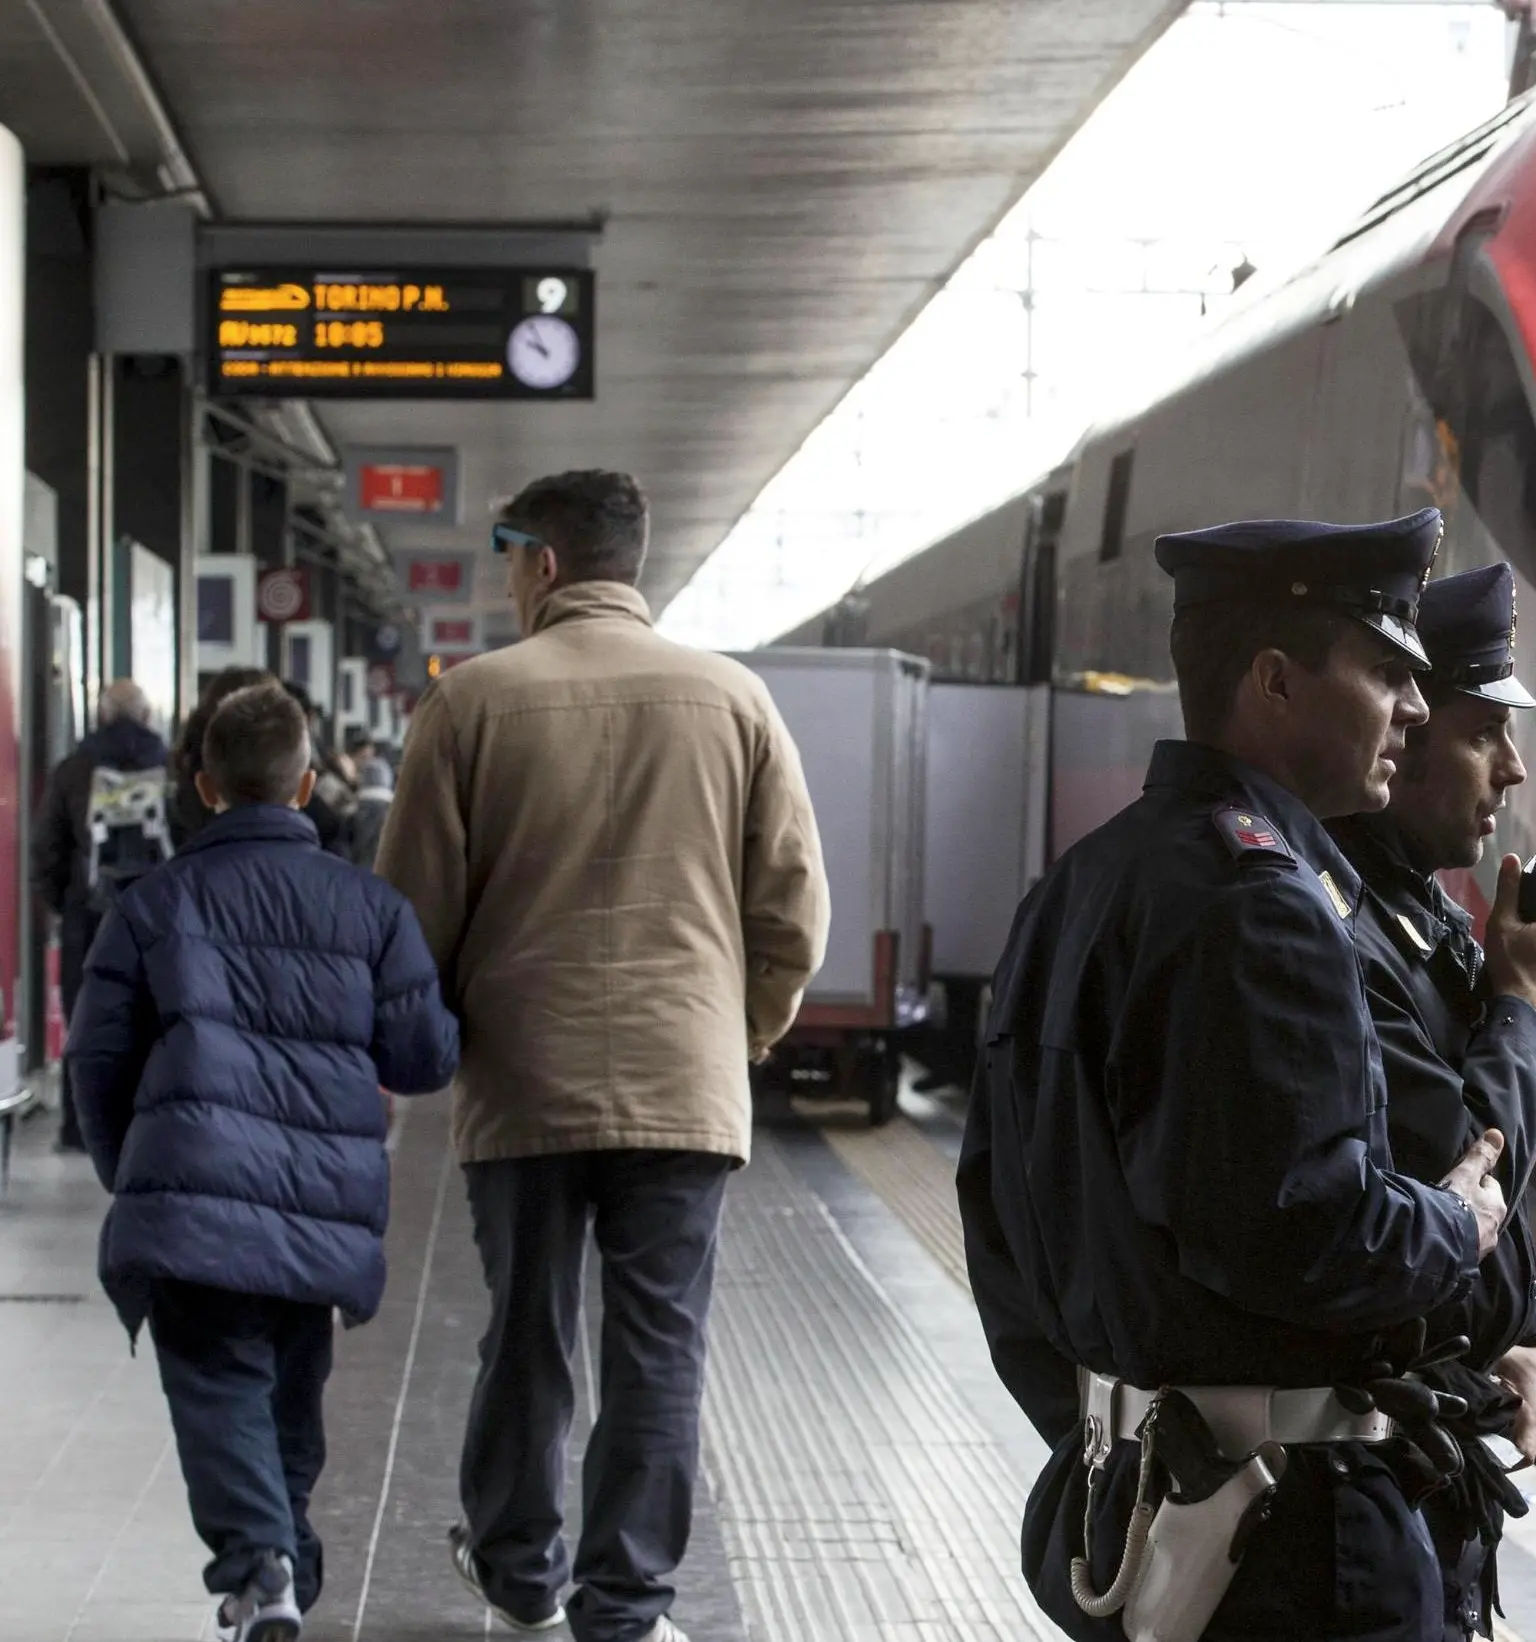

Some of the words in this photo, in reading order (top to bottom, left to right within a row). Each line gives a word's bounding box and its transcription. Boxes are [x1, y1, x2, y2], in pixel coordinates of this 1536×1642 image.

[314, 284, 401, 312] TORINO
[536, 276, 568, 314] 9
[314, 320, 385, 349] 10:05
